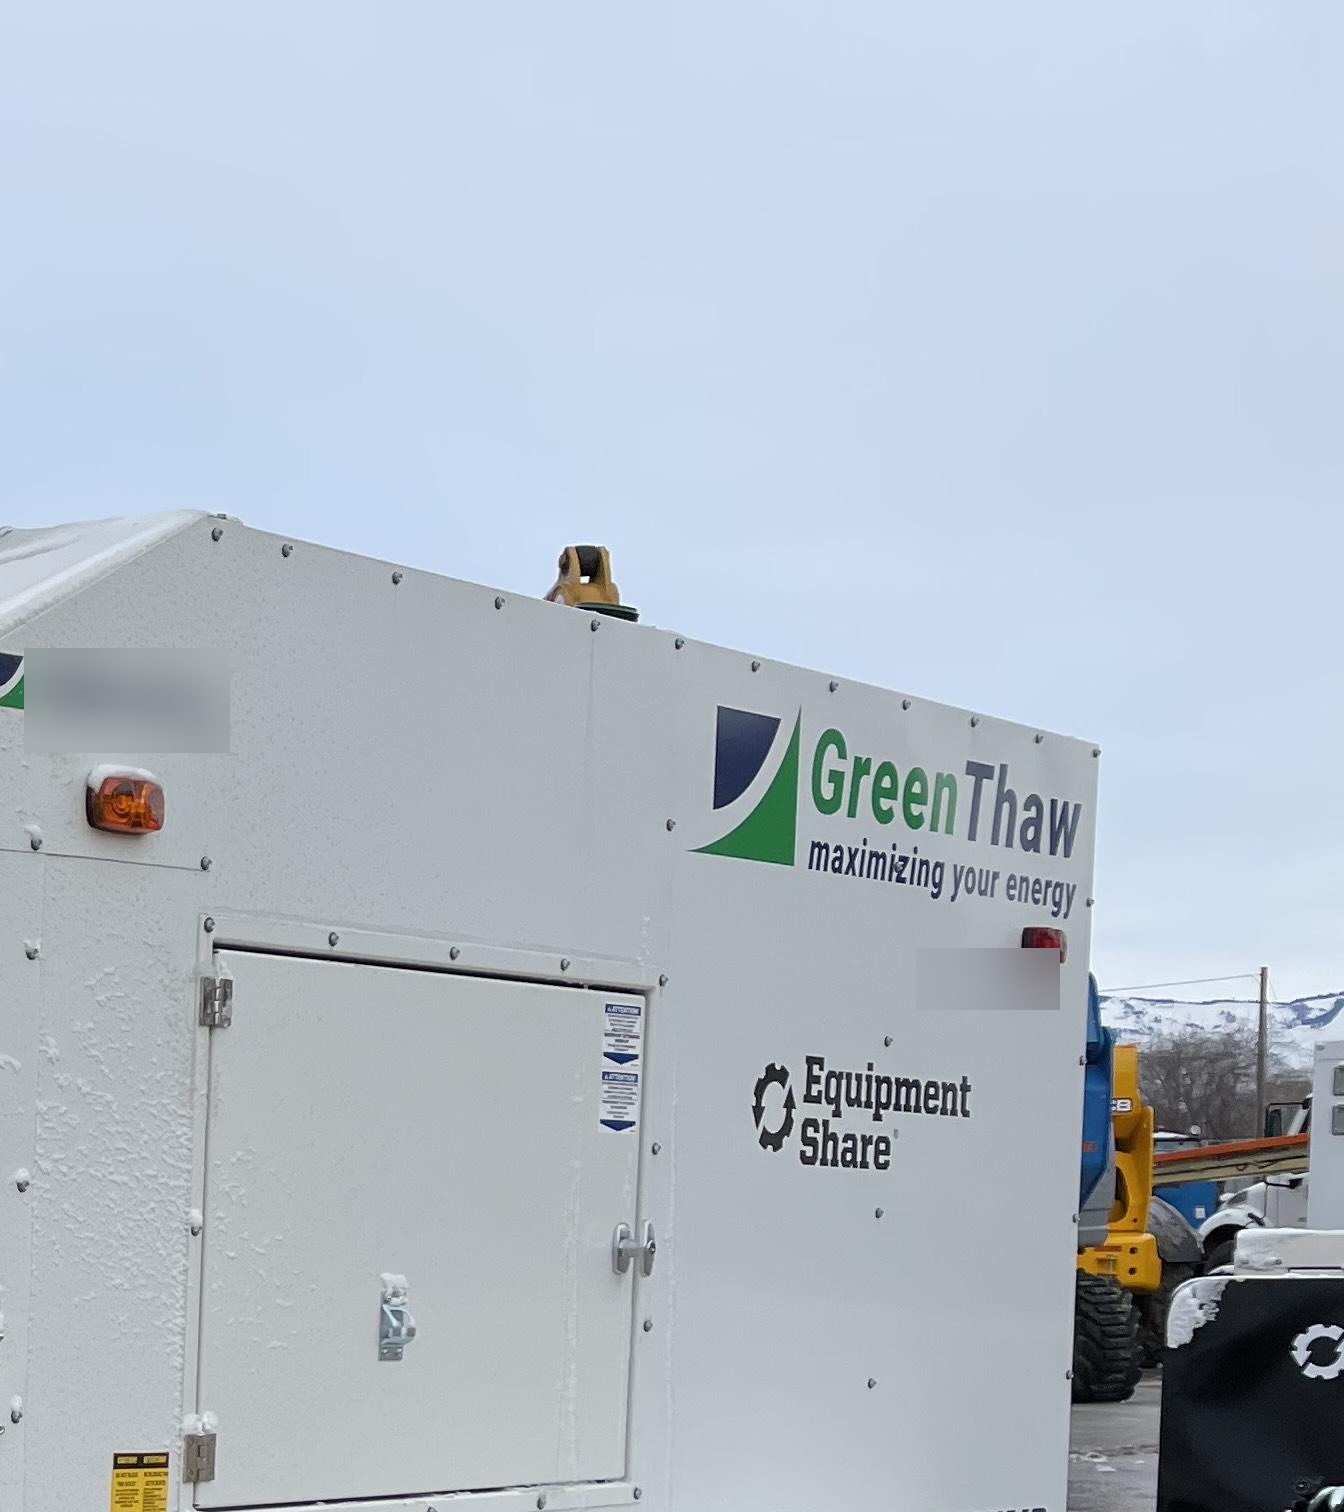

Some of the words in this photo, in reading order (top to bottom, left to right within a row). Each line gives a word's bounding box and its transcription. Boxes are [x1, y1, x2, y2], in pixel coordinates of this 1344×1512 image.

[807, 837, 945, 900] maximizing
[950, 861, 1001, 903] your
[1006, 872, 1078, 920] energy
[803, 1055, 972, 1122] Equipment
[799, 1117, 892, 1171] Share
